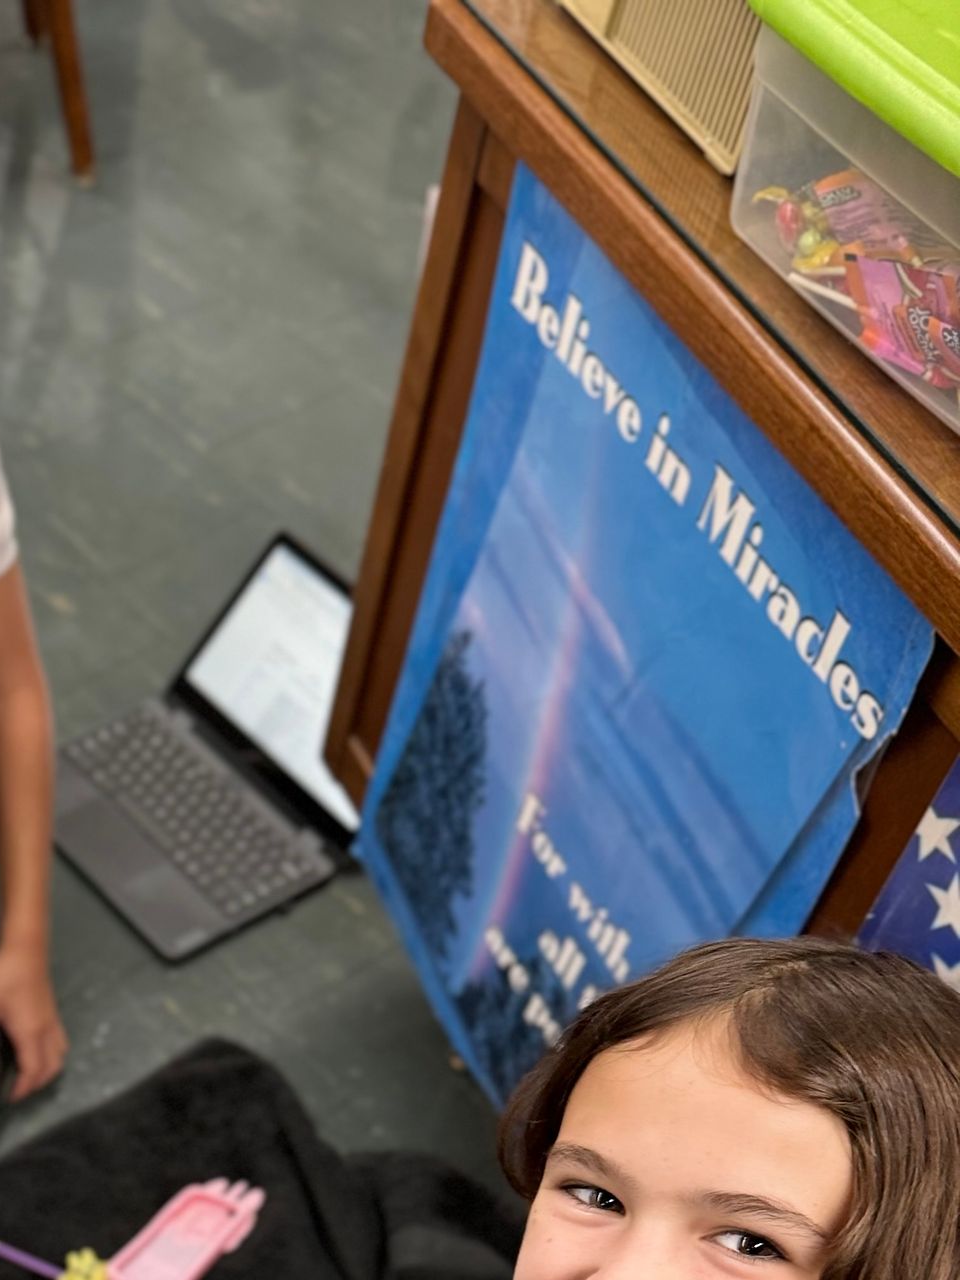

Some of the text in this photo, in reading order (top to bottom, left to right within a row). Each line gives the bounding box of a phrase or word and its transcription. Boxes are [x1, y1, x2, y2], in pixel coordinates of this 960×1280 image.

[510, 243, 884, 740] Believe in Miracles
[517, 794, 567, 878] For
[569, 882, 630, 982] with
[538, 930, 587, 989] all
